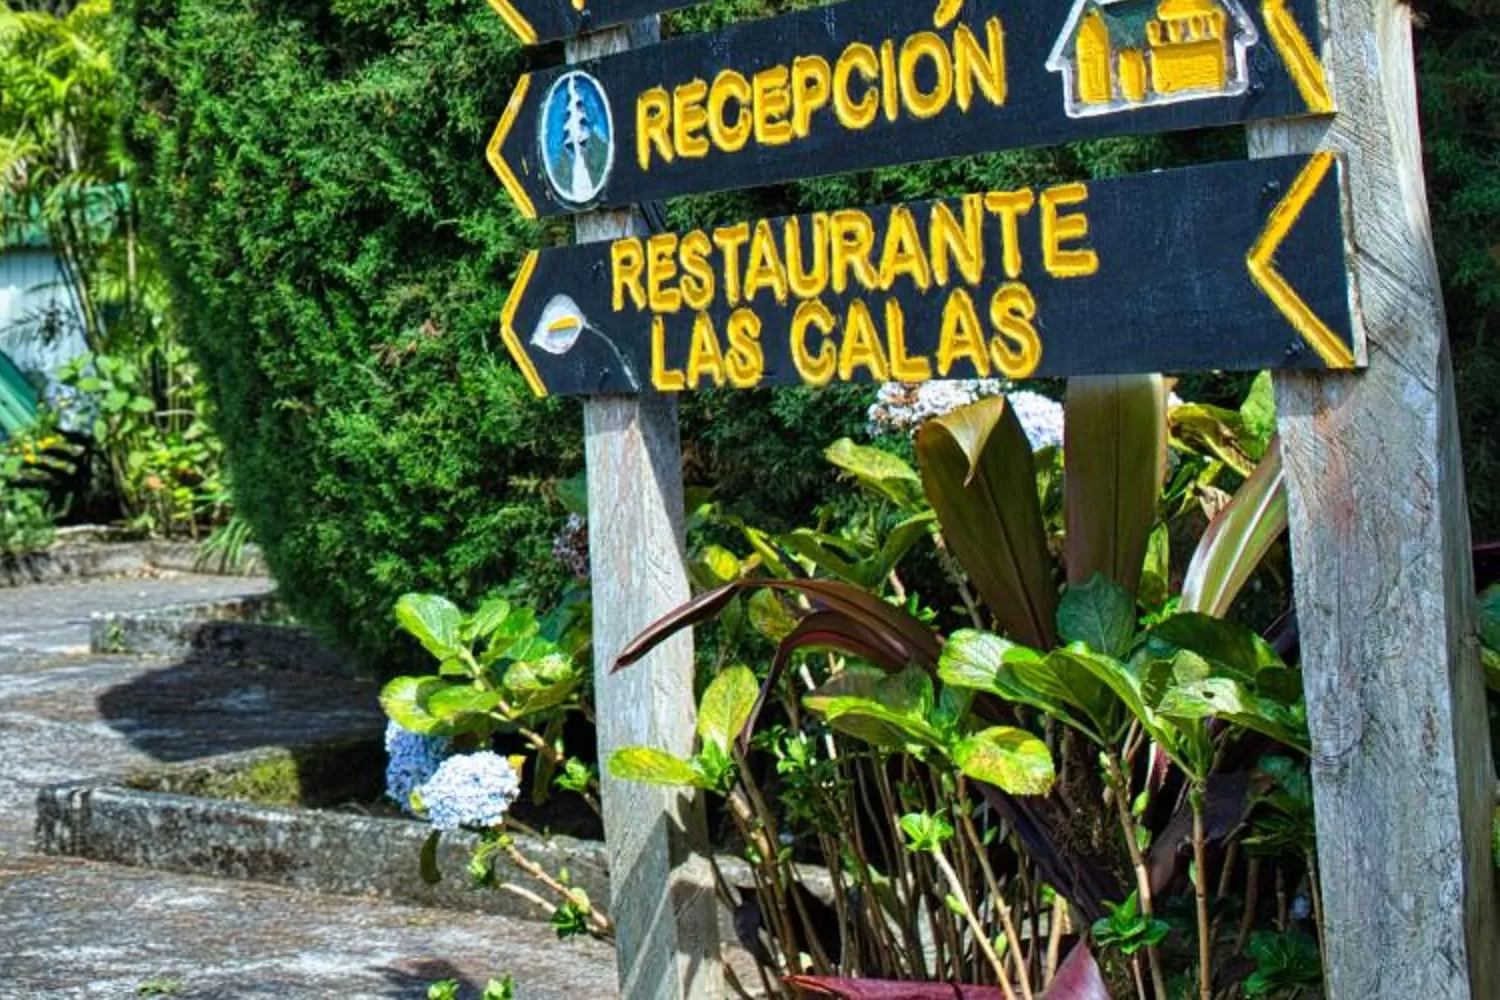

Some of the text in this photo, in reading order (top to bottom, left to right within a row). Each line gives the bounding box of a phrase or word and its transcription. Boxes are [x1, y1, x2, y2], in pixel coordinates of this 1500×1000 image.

[610, 182, 1100, 313] RESTAURANTE
[650, 282, 1044, 393] LAS CALAS
